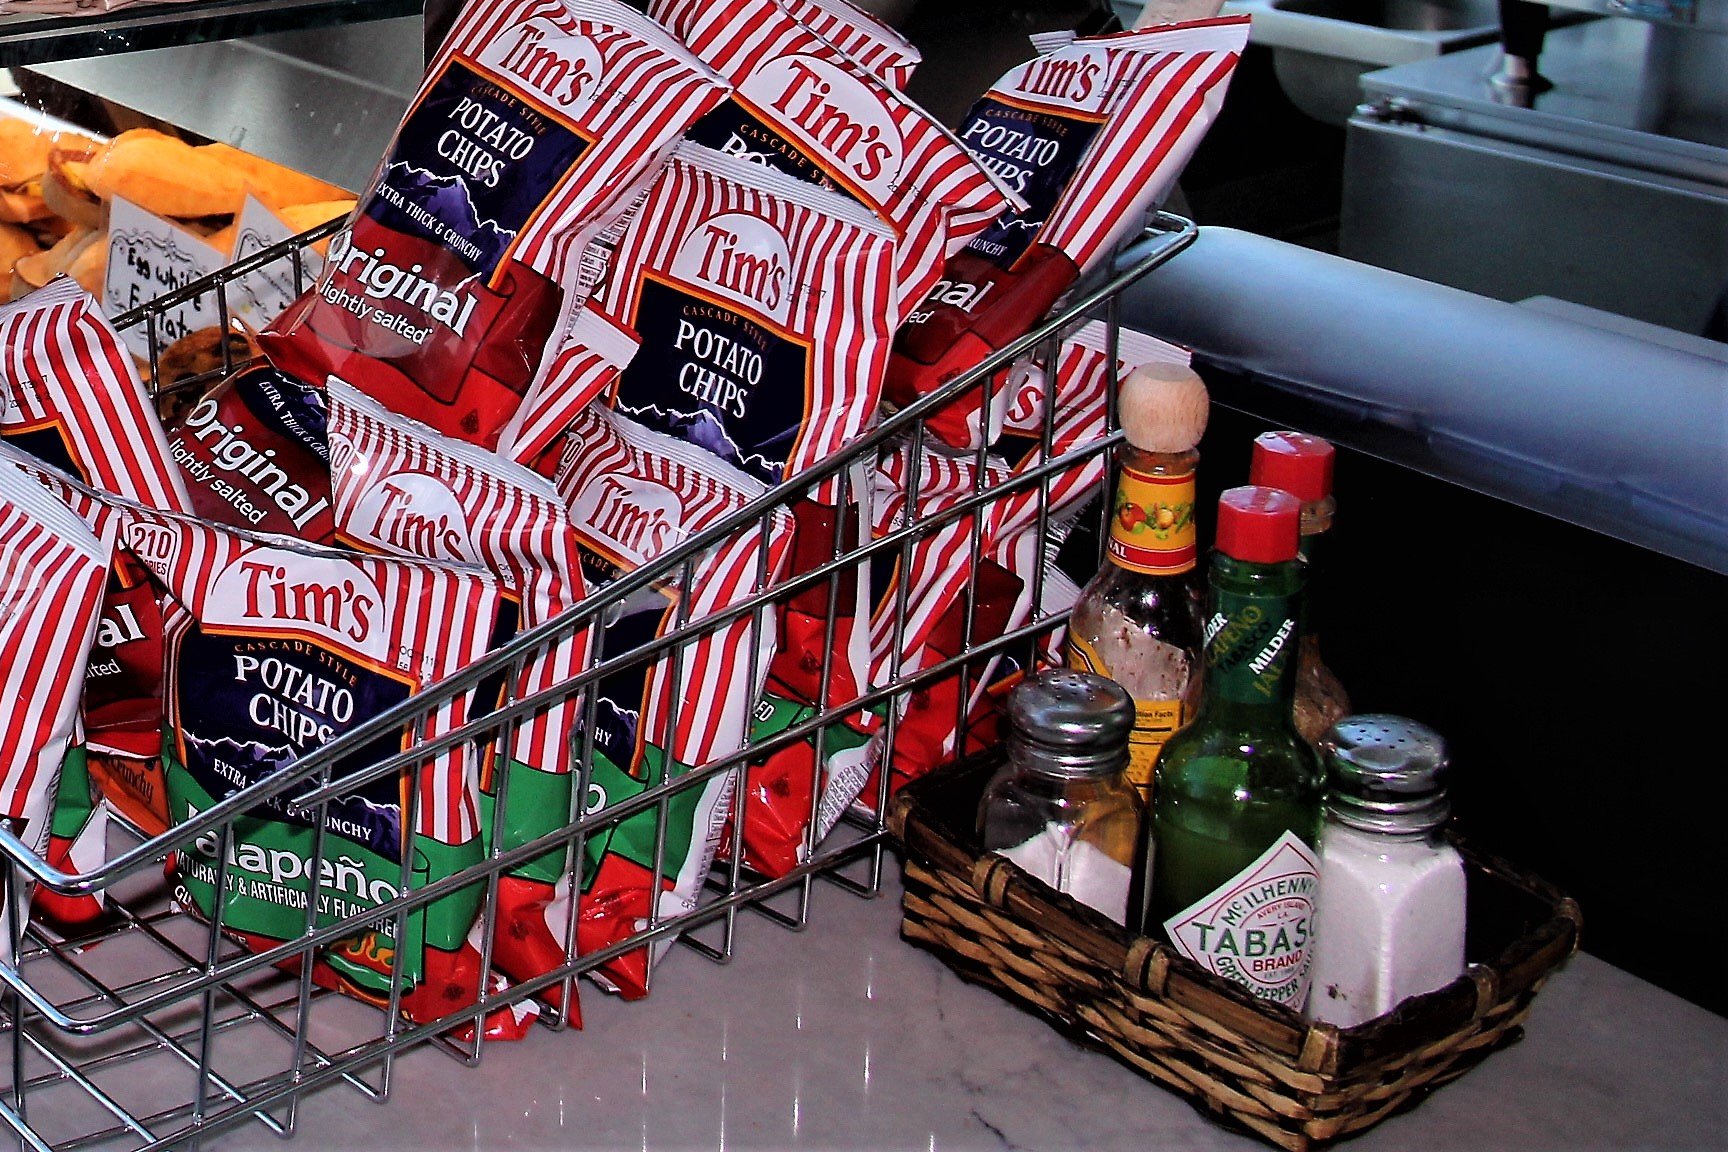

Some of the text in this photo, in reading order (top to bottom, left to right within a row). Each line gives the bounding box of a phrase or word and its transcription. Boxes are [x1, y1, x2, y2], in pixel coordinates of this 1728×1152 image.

[498, 23, 594, 107] Tim's
[447, 96, 535, 160] POTATO
[740, 124, 807, 168] CASCADE
[770, 59, 893, 181] Tim's
[961, 117, 1060, 167] POTATO
[437, 129, 506, 188] CHIPS
[968, 149, 1034, 194] HIPS
[375, 182, 484, 262] EXTRA THICK & CRUNCHY
[968, 238, 1008, 257] UNCHY
[127, 247, 151, 281] Egg
[328, 230, 478, 338] Original
[696, 224, 786, 311] Tim's
[320, 279, 373, 320] lightly
[372, 308, 428, 346] salted
[683, 305, 738, 326] CASCADE
[673, 318, 763, 386] POTATO
[258, 380, 286, 412] EXTRA
[279, 410, 306, 439] THICK
[679, 362, 749, 419] CHIPS
[170, 436, 268, 525] lightly salted
[185, 399, 329, 532] Original
[133, 525, 172, 559] 210
[369, 482, 466, 563] Tim's
[585, 475, 671, 562] Tim's
[239, 560, 374, 643] Tim's
[86, 658, 122, 679] lted
[234, 640, 357, 687] CASCADE STYLE
[1248, 618, 1295, 675] MILDER
[233, 654, 354, 724] POTATO
[249, 692, 335, 749] CHIPS
[213, 758, 247, 790] EXTRA
[302, 808, 372, 841] CUNCHY
[175, 848, 235, 891] NATURAY
[238, 879, 248, 896] &
[250, 880, 330, 915] ARTIFICIALY
[187, 799, 400, 906] alapeño
[1191, 914, 1314, 958] TABAS
[1253, 949, 1304, 973] BRAND
[1256, 979, 1300, 1001] PEPPER
